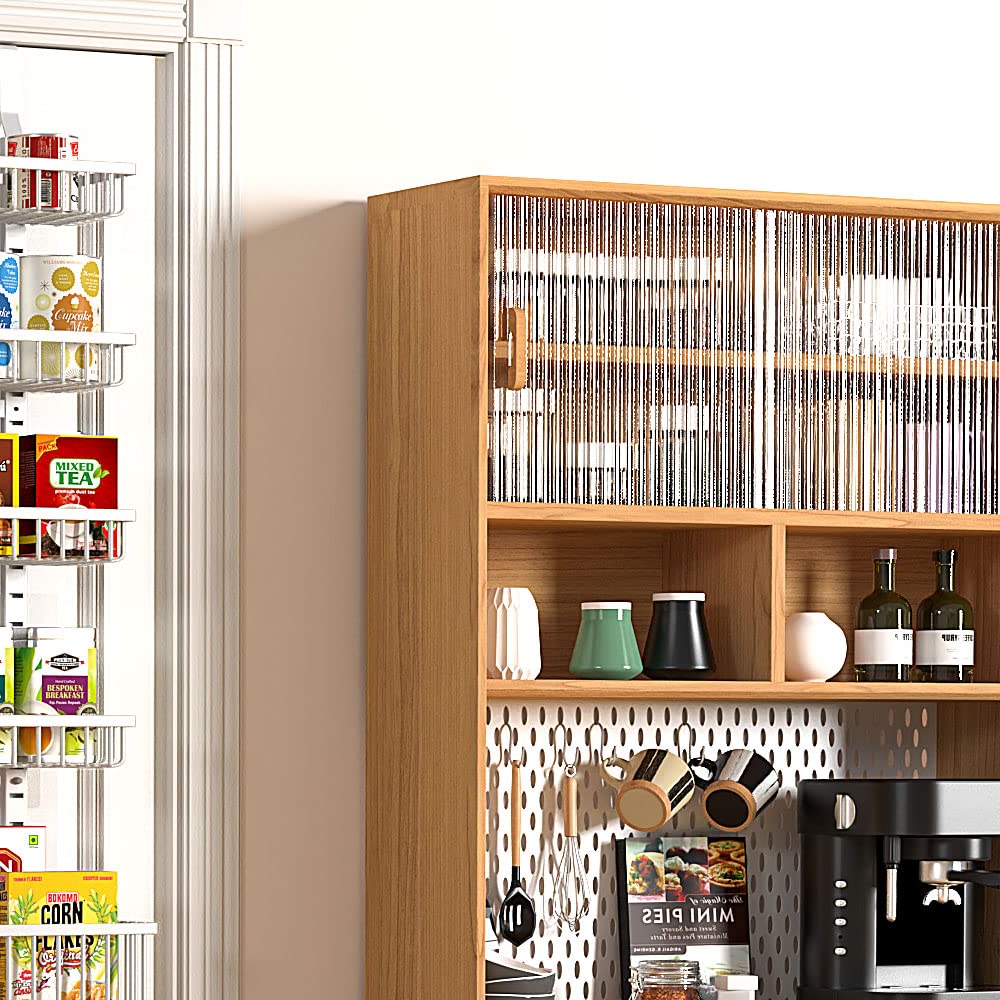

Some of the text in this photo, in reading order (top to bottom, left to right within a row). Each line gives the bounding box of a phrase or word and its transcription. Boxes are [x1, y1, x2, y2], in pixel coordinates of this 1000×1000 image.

[54, 308, 92, 323] Cupcake
[38, 443, 56, 453] PACK
[56, 462, 94, 472] MIXED
[56, 471, 94, 486] TEA
[48, 894, 78, 902] BOKOMO
[41, 902, 83, 924] CORN
